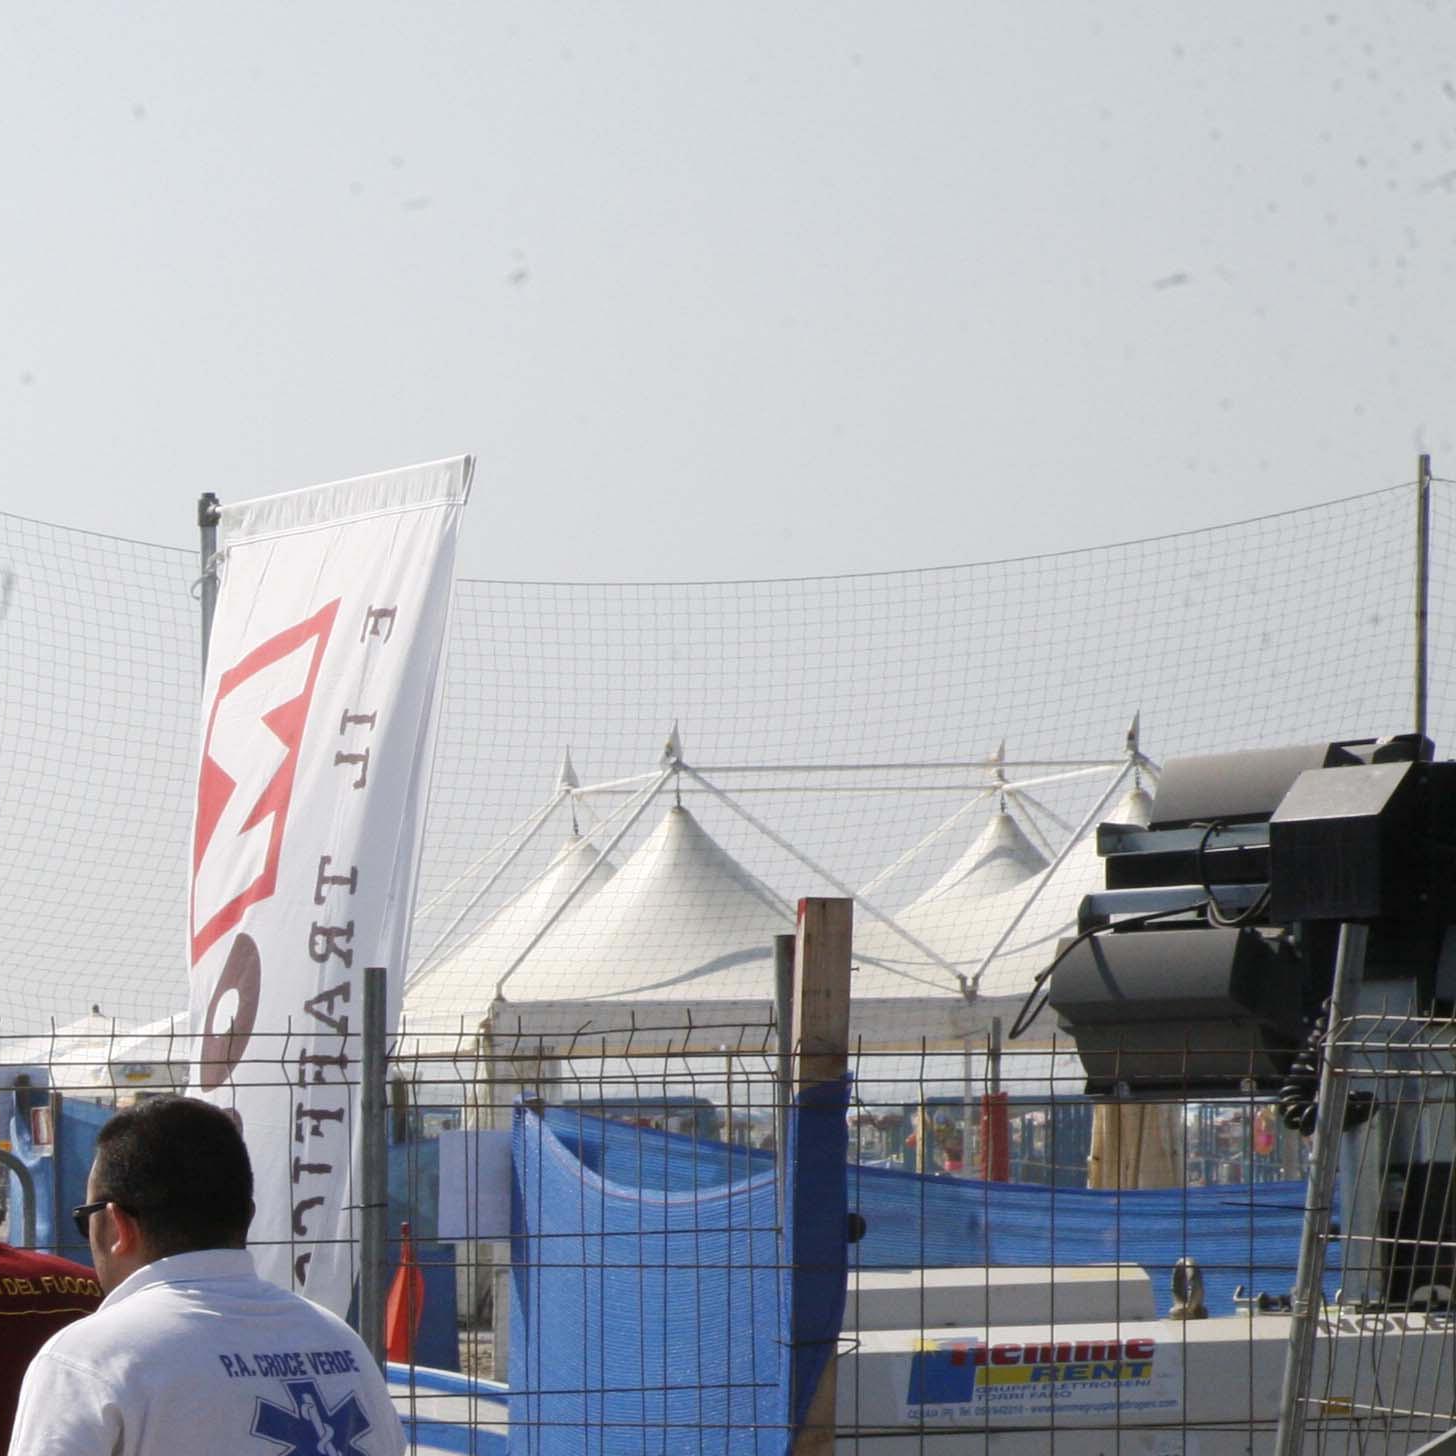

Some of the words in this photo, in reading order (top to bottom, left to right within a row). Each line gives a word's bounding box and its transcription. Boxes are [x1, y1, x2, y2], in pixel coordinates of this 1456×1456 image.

[2, 1276, 41, 1296] DEL
[41, 1274, 102, 1298] FUOCO
[219, 1353, 256, 1378] P.A.
[253, 1352, 307, 1378] CROCE
[307, 1349, 360, 1376] VERDE
[1030, 1361, 1151, 1382] RENT
